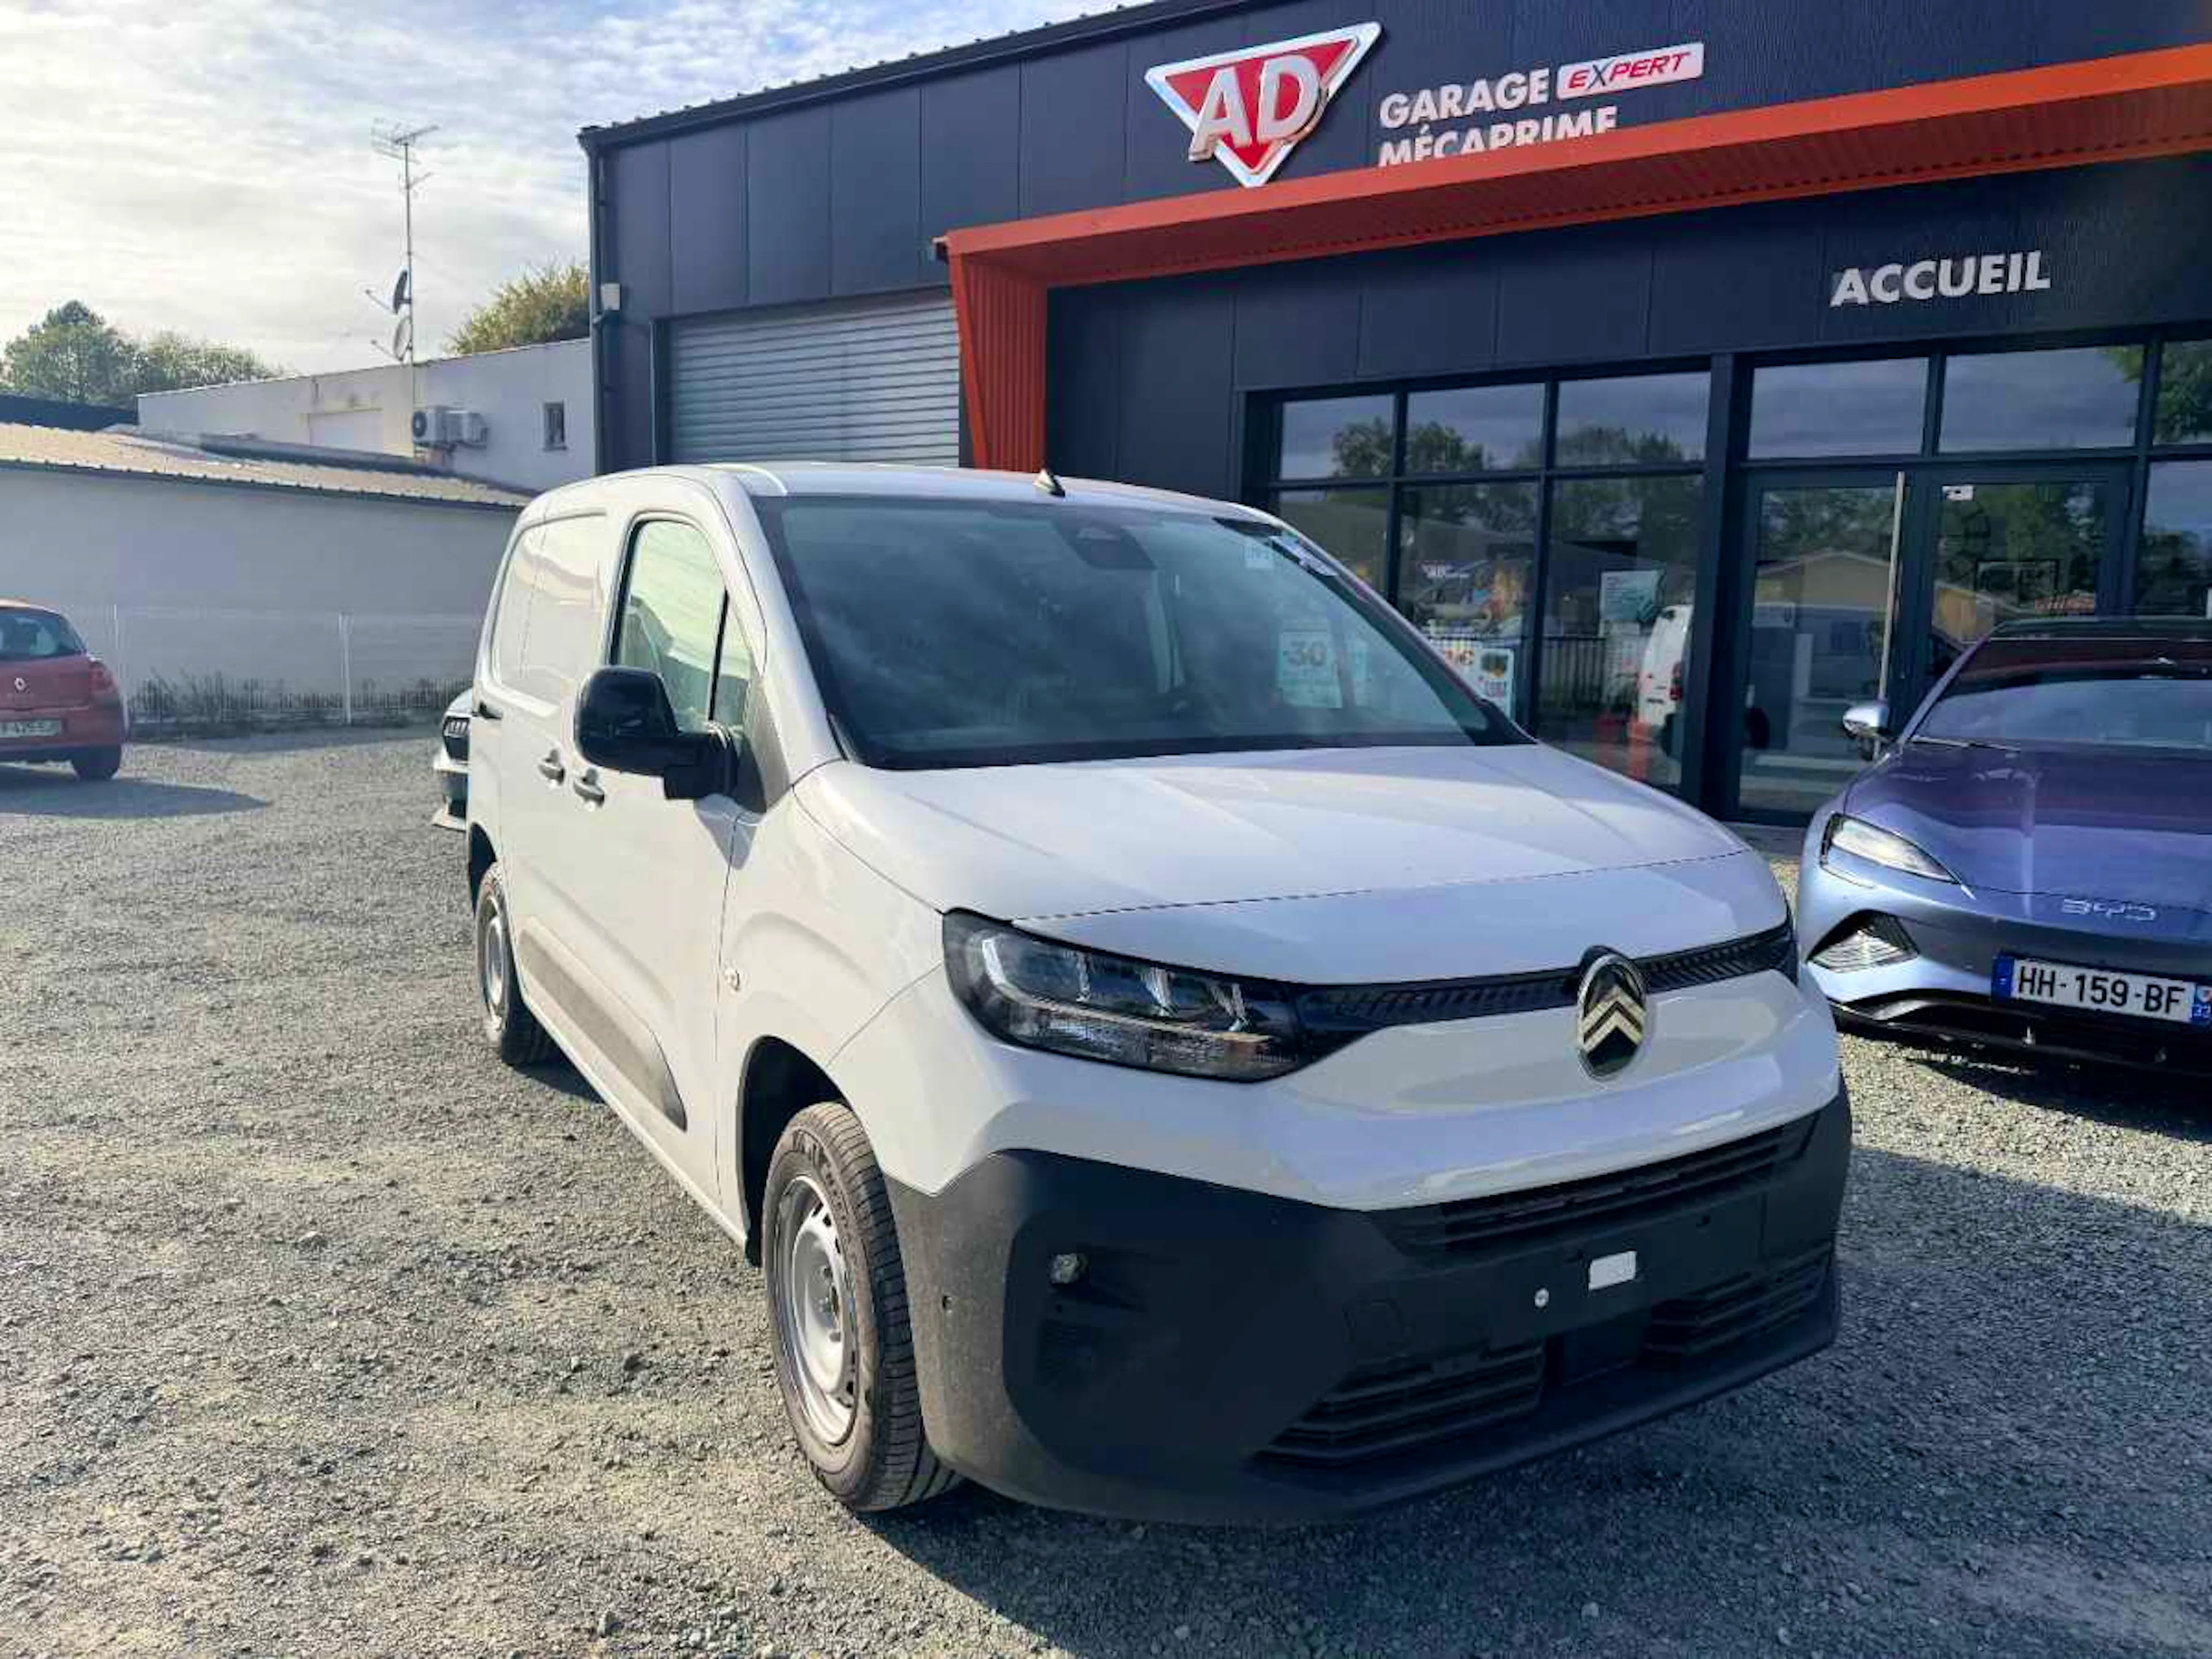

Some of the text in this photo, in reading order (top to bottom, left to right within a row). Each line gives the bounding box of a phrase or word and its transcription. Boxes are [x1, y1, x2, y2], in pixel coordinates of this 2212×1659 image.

[1568, 51, 1691, 89] EXPERT
[1188, 54, 1325, 161] AD
[1380, 67, 1550, 128] GARAGE
[1830, 249, 2051, 307] ACCUEIL
[2061, 897, 2156, 922] BYD
[2018, 965, 2186, 1014] HH-159-BF
